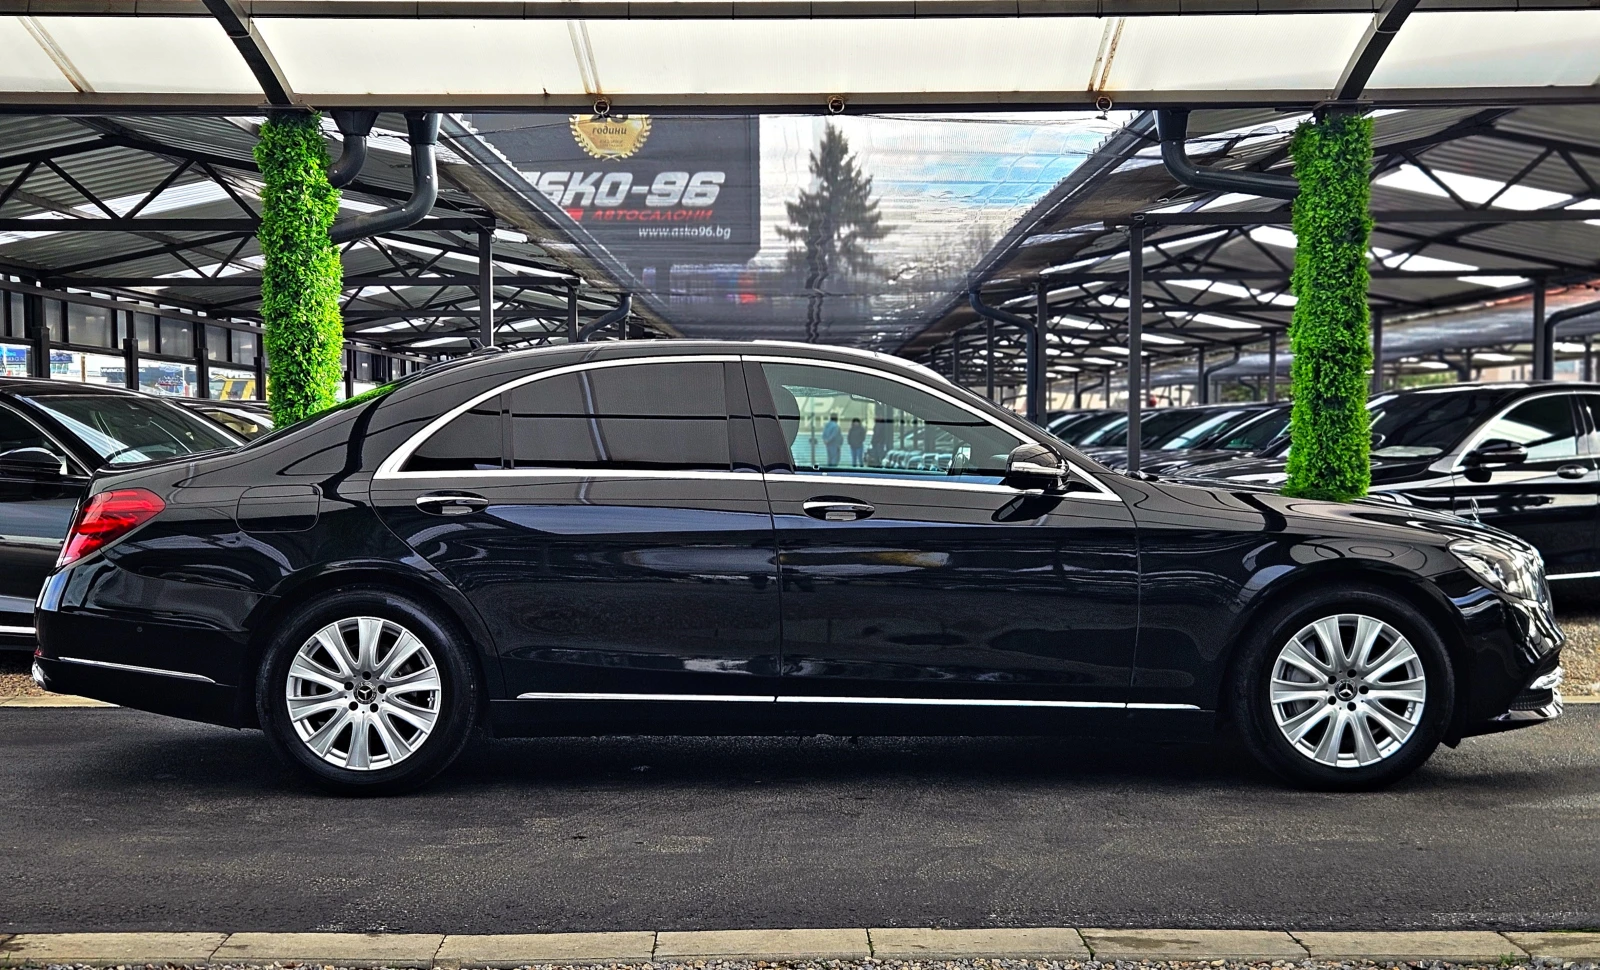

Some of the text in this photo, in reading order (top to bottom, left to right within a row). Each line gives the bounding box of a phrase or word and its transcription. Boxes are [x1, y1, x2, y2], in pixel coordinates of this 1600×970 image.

[592, 125, 627, 135] години
[592, 208, 713, 221] АВТОСАЛОНИ
[638, 225, 731, 239] www.asko96.bg
